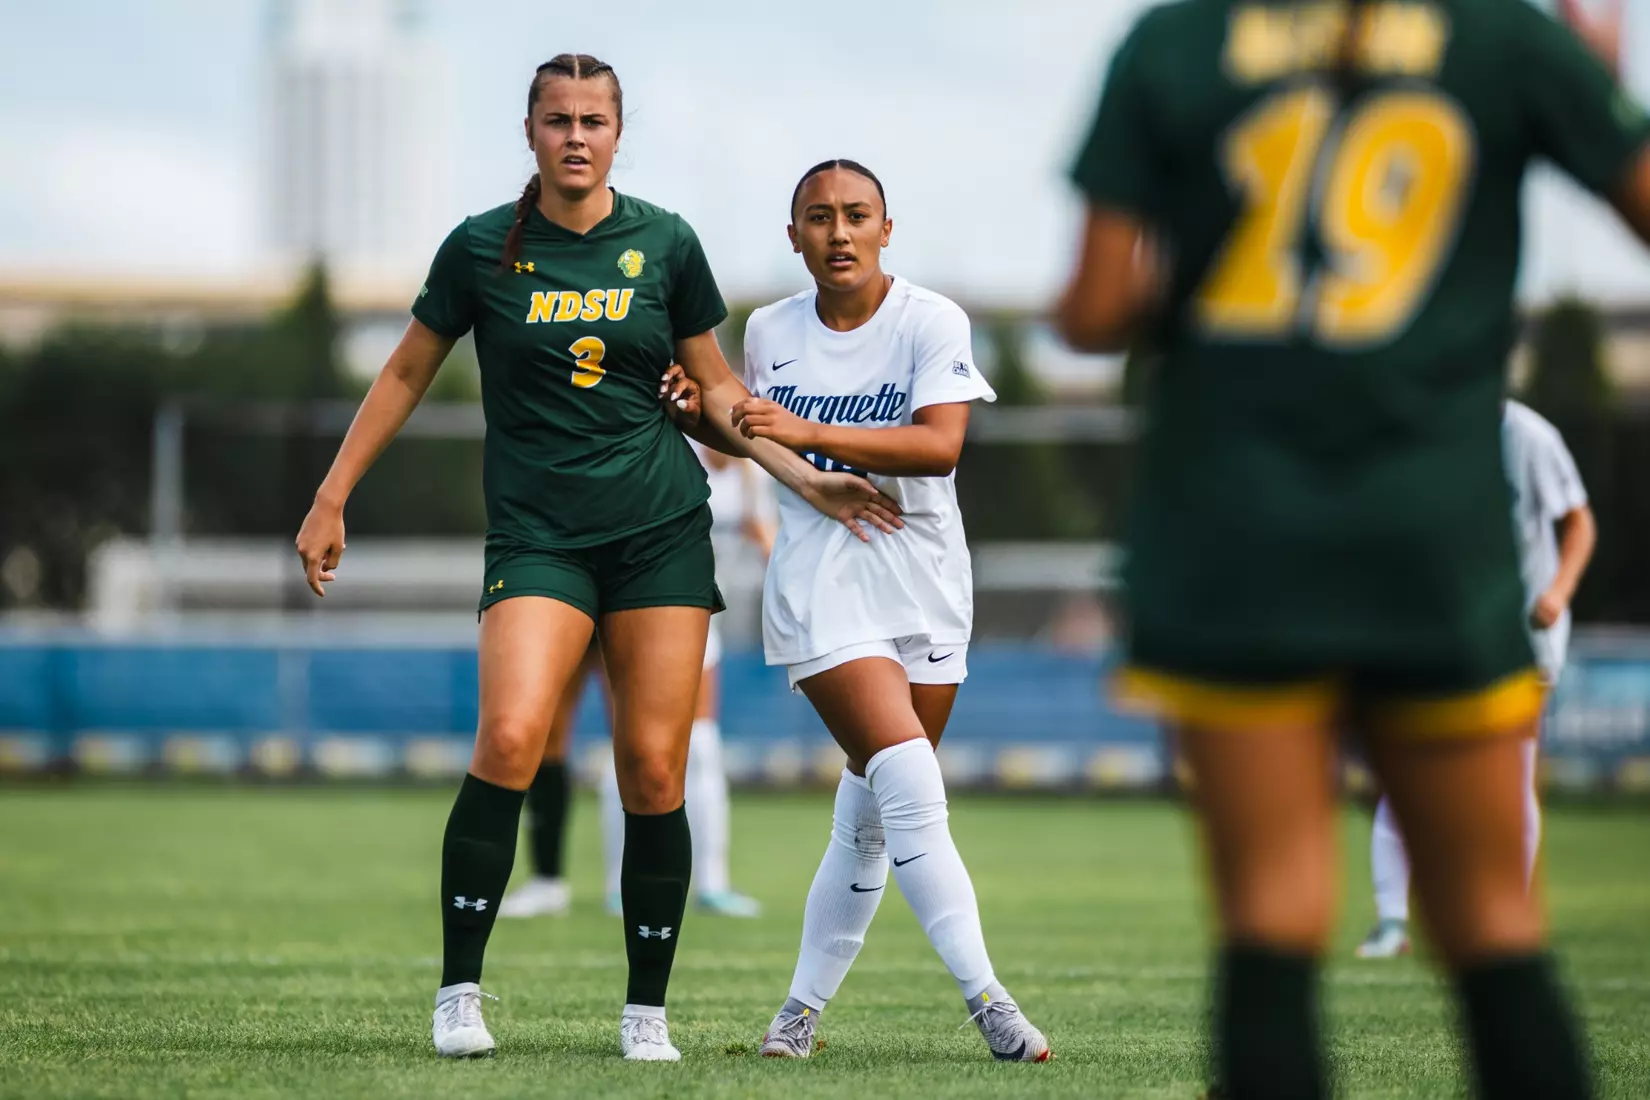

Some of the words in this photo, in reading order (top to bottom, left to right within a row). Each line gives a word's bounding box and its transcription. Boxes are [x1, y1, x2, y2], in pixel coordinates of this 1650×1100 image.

[1199, 86, 1474, 348] 19
[525, 288, 634, 323] NDSU
[568, 336, 606, 388] 3
[767, 383, 906, 424] Marquette
